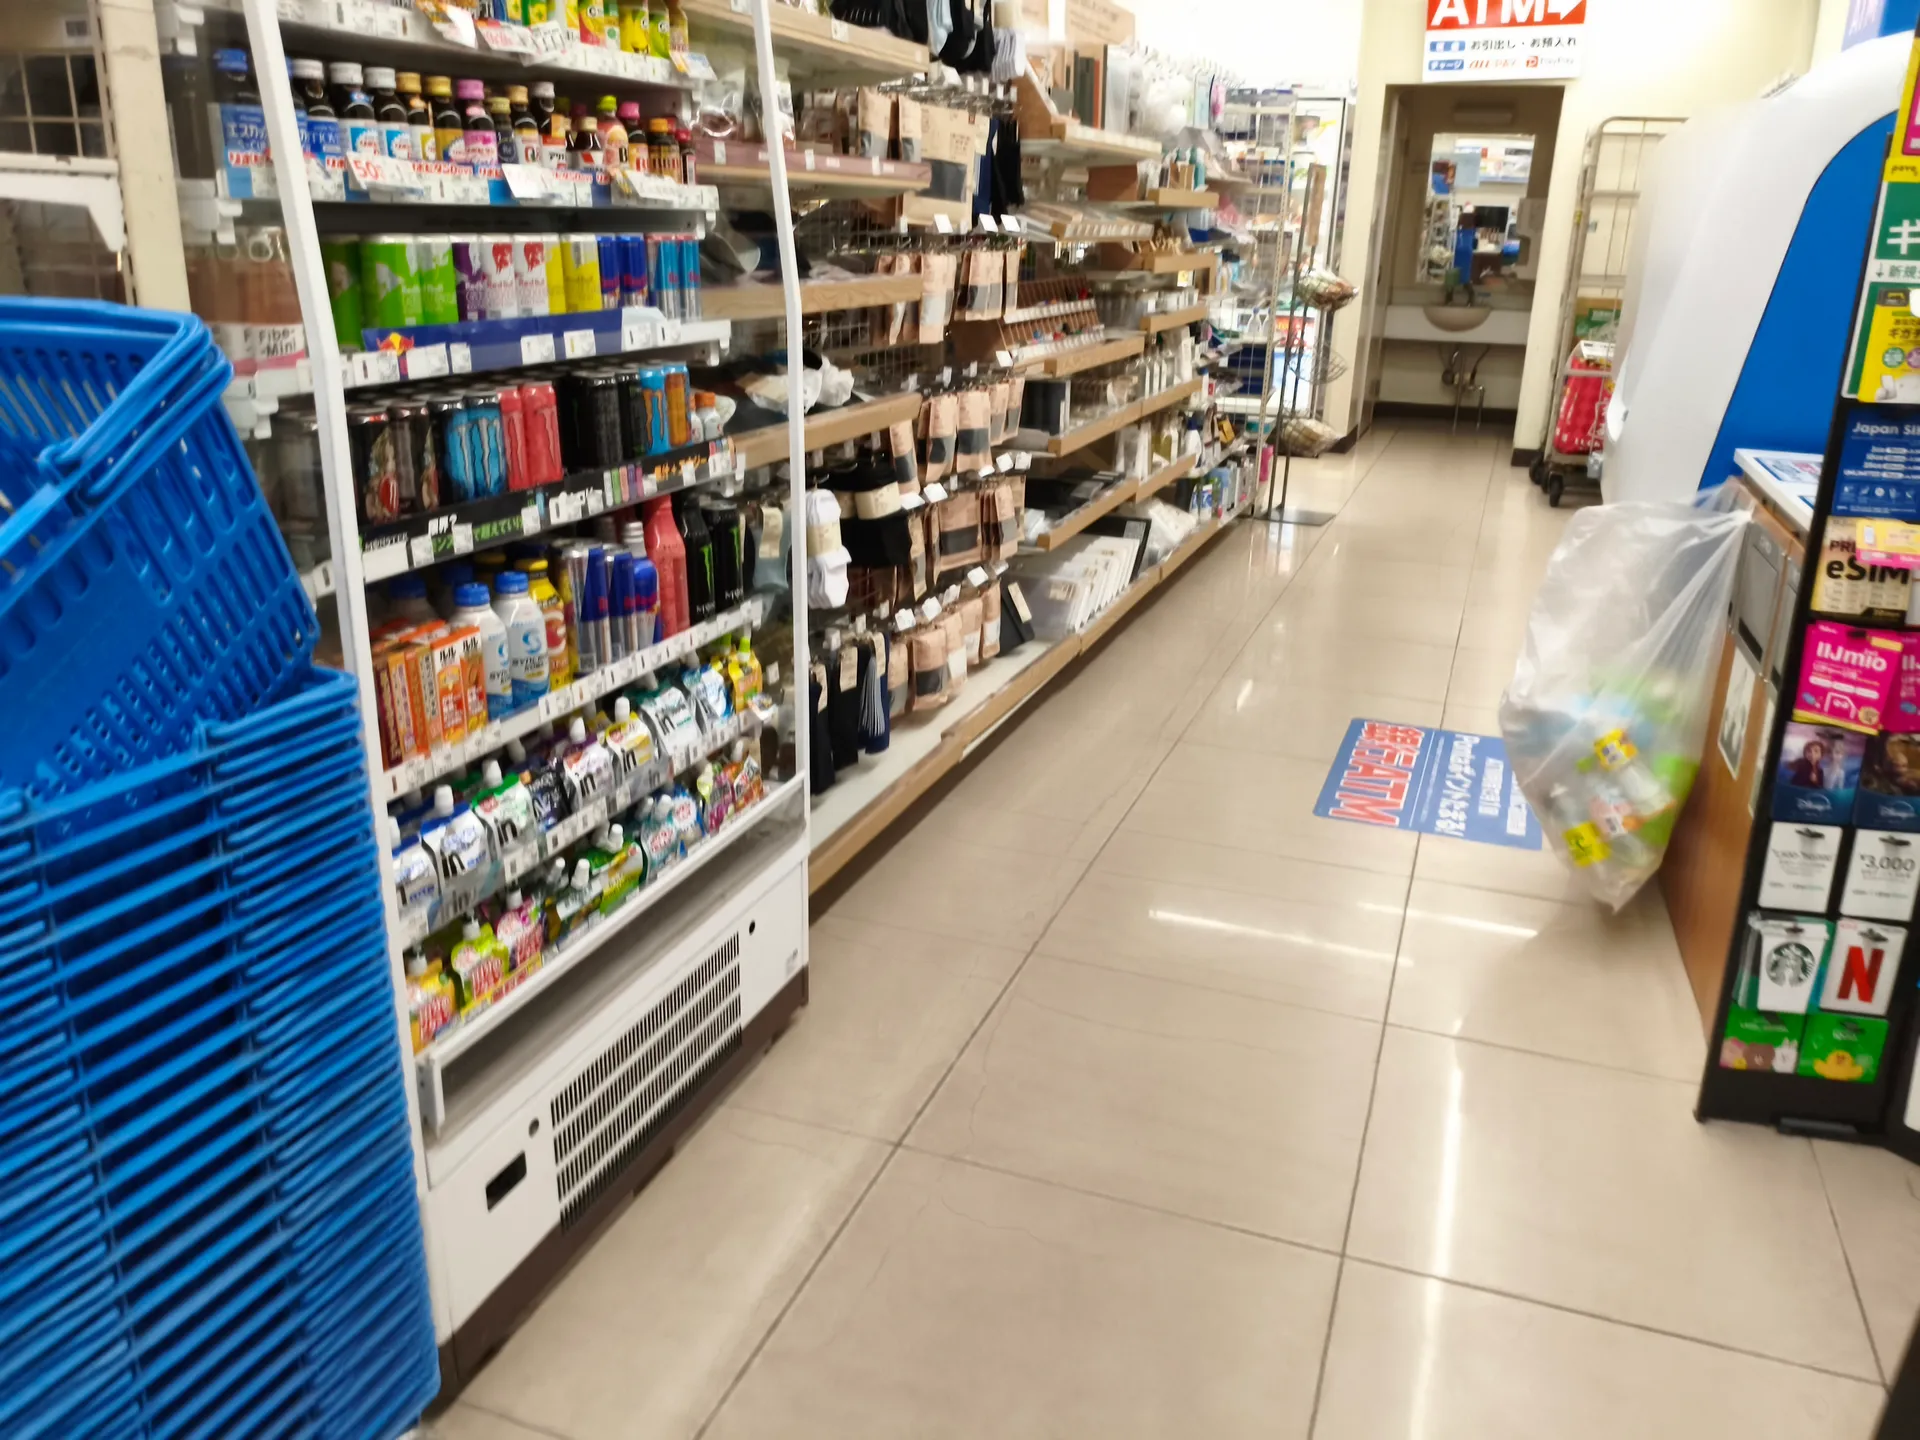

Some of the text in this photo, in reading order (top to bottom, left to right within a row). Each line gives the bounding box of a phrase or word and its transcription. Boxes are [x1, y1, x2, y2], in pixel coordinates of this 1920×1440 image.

[1852, 421, 1899, 436] Japan
[1827, 555, 1910, 585] eSIM
[1328, 719, 1425, 827] 銀行ATM
[1837, 945, 1885, 1003] N
